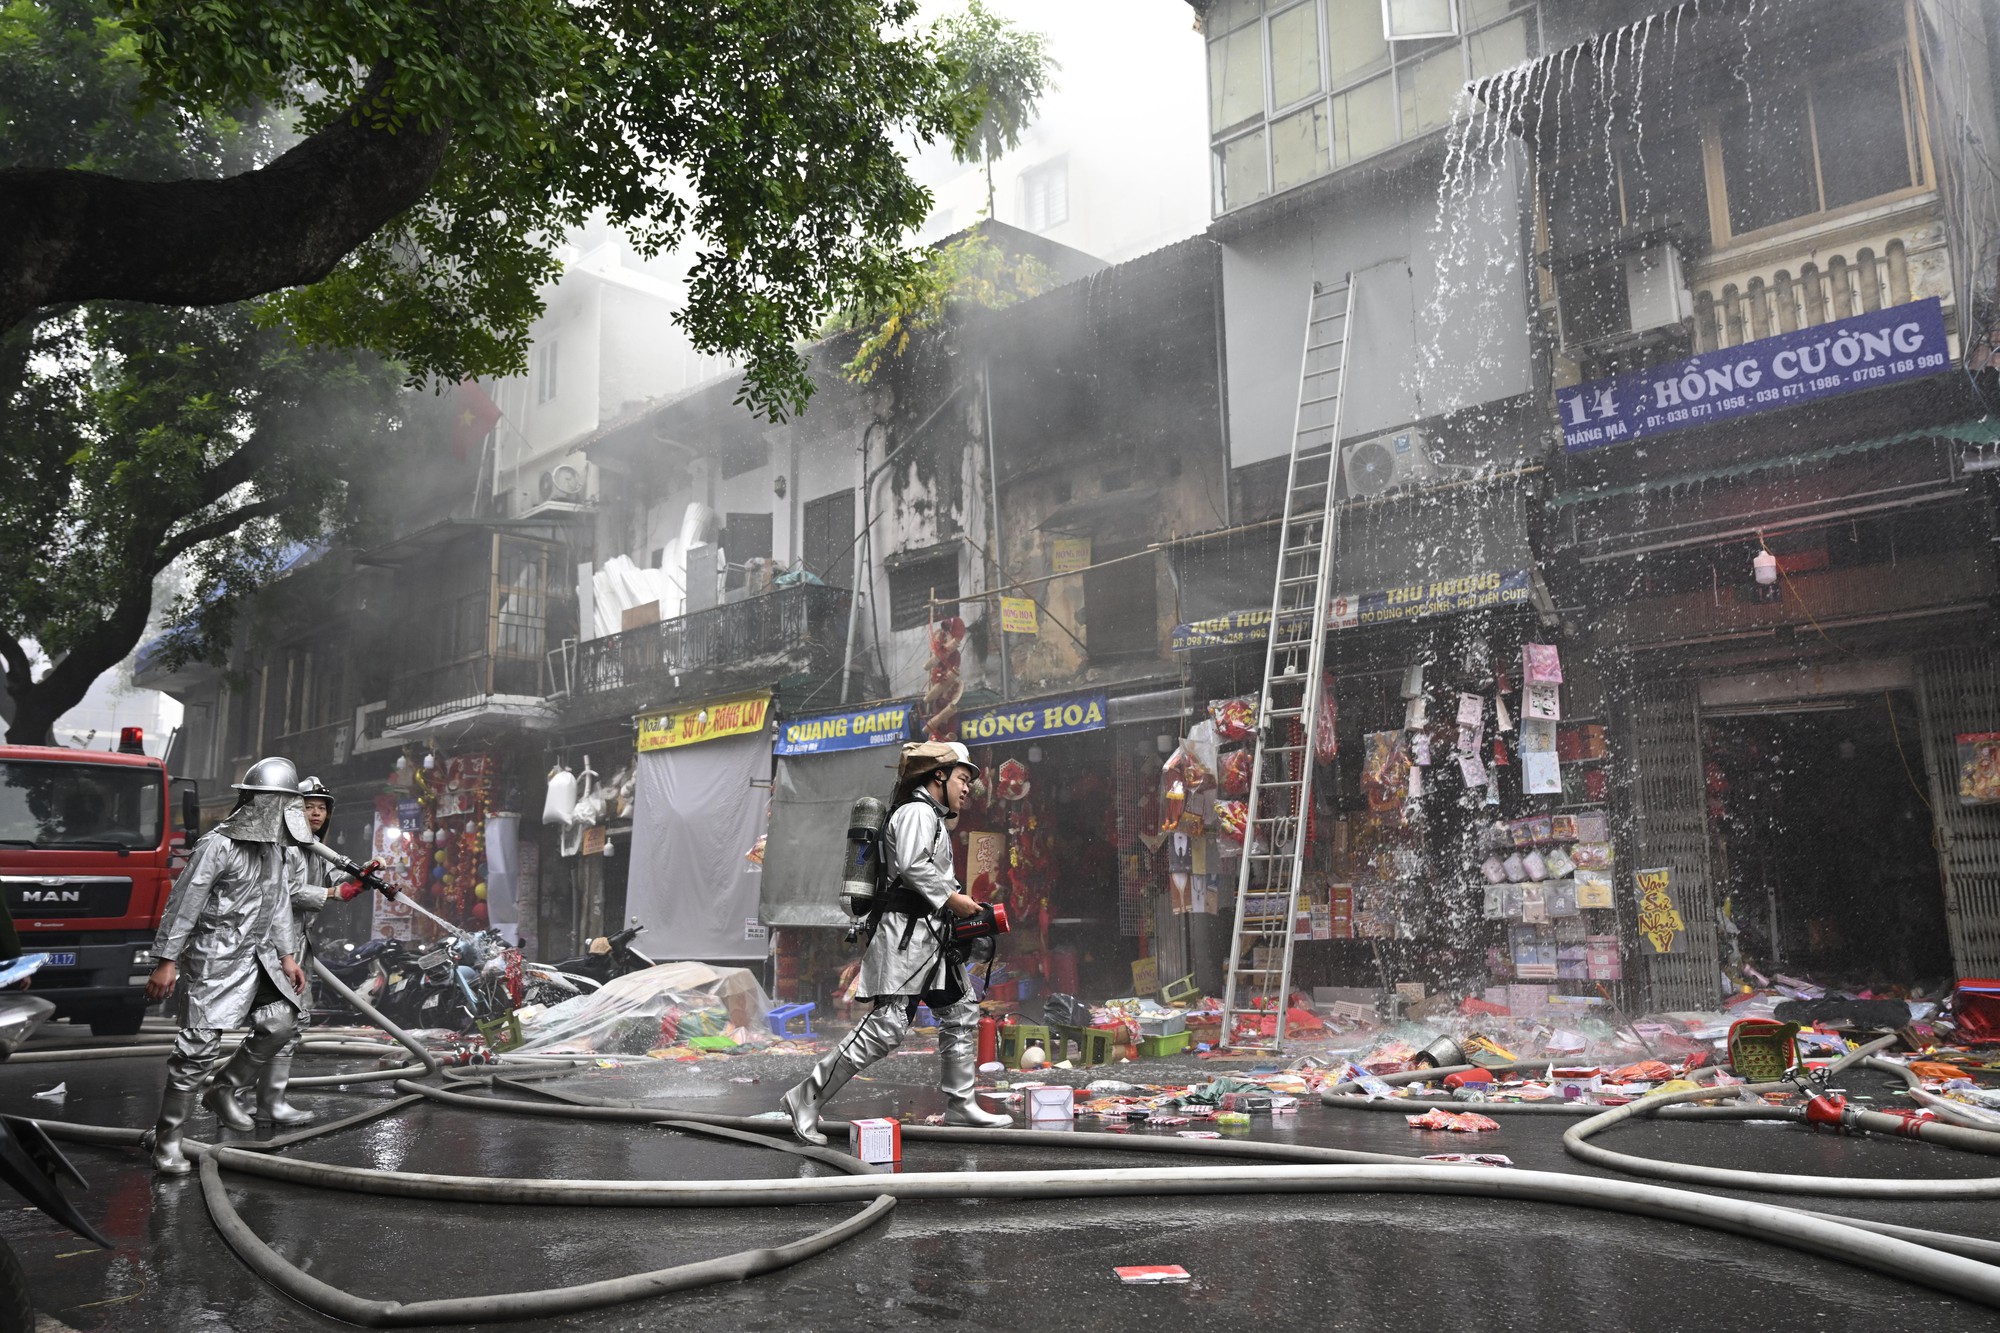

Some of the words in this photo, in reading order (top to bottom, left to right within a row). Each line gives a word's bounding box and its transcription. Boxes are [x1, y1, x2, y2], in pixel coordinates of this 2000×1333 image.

[1653, 358, 1762, 409] HỒNG
[1772, 322, 1924, 376] CƯỜNG
[1667, 408, 1689, 424] 038
[1691, 403, 1711, 417] 671
[1716, 396, 1745, 412] 1958
[1756, 388, 1778, 404] 038
[1782, 383, 1805, 398] 671
[1809, 376, 1840, 393] 1986
[1853, 365, 1885, 382] 0705
[1889, 360, 1914, 375] 168
[1917, 353, 1944, 369] 980
[1564, 387, 1620, 426] 14
[1567, 427, 1602, 446] HÀNG
[1605, 420, 1628, 438] MÃ
[1377, 607, 1402, 621] DÙNG
[1502, 588, 1527, 602] CUTE
[1386, 585, 1423, 605] THU
[787, 717, 848, 744] QUANG
[852, 710, 904, 734] OANH
[1043, 702, 1103, 729] HOA
[403, 818, 416, 829] 24
[23, 891, 80, 902] MAN
